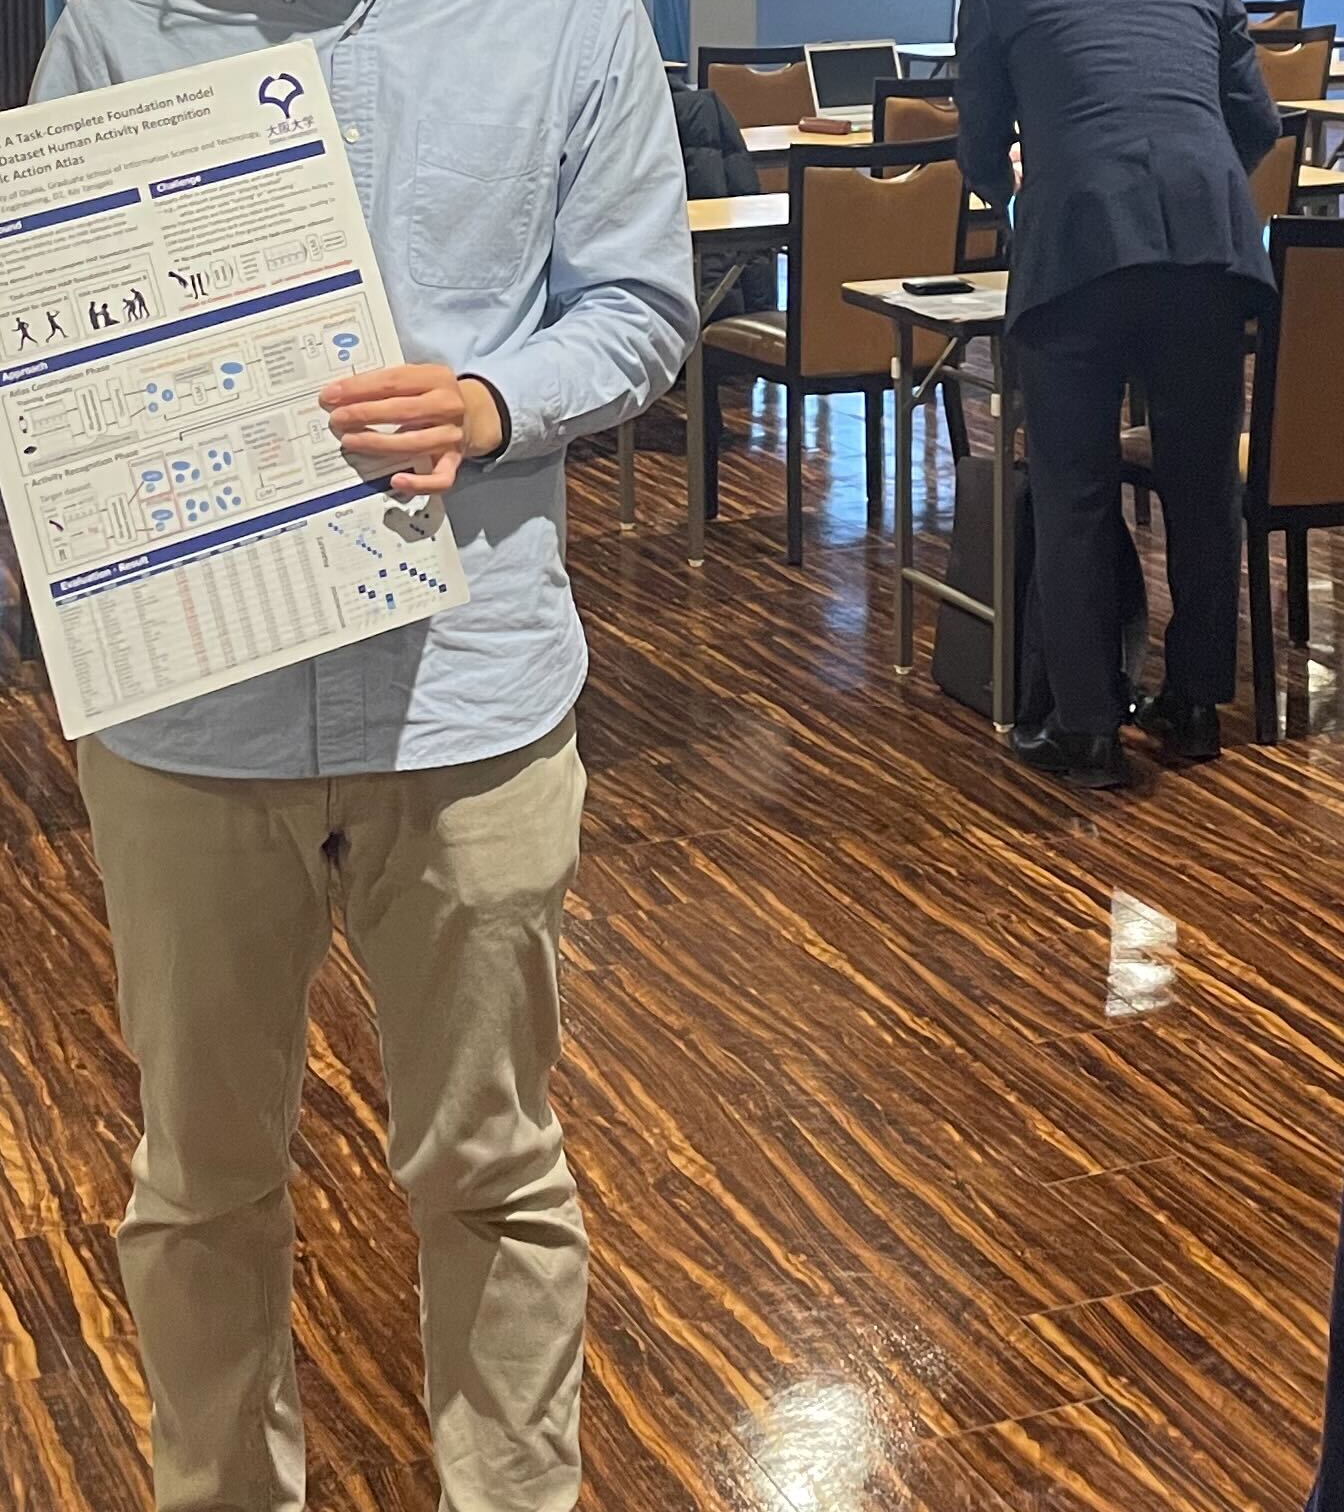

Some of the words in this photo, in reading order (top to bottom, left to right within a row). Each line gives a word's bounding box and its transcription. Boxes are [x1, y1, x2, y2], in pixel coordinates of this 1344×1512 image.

[4, 136, 14, 147] A
[14, 114, 104, 143] Task-Complete
[105, 98, 174, 121] Foundation
[175, 85, 214, 104] Model
[265, 114, 314, 138] 大阪大学
[46, 136, 91, 154] Human
[94, 124, 139, 143] Activity
[140, 106, 211, 130] Recognition
[12, 163, 52, 180] Action
[54, 155, 85, 170] Atlas
[155, 174, 201, 192] Challenge
[1, 361, 48, 382] Approach
